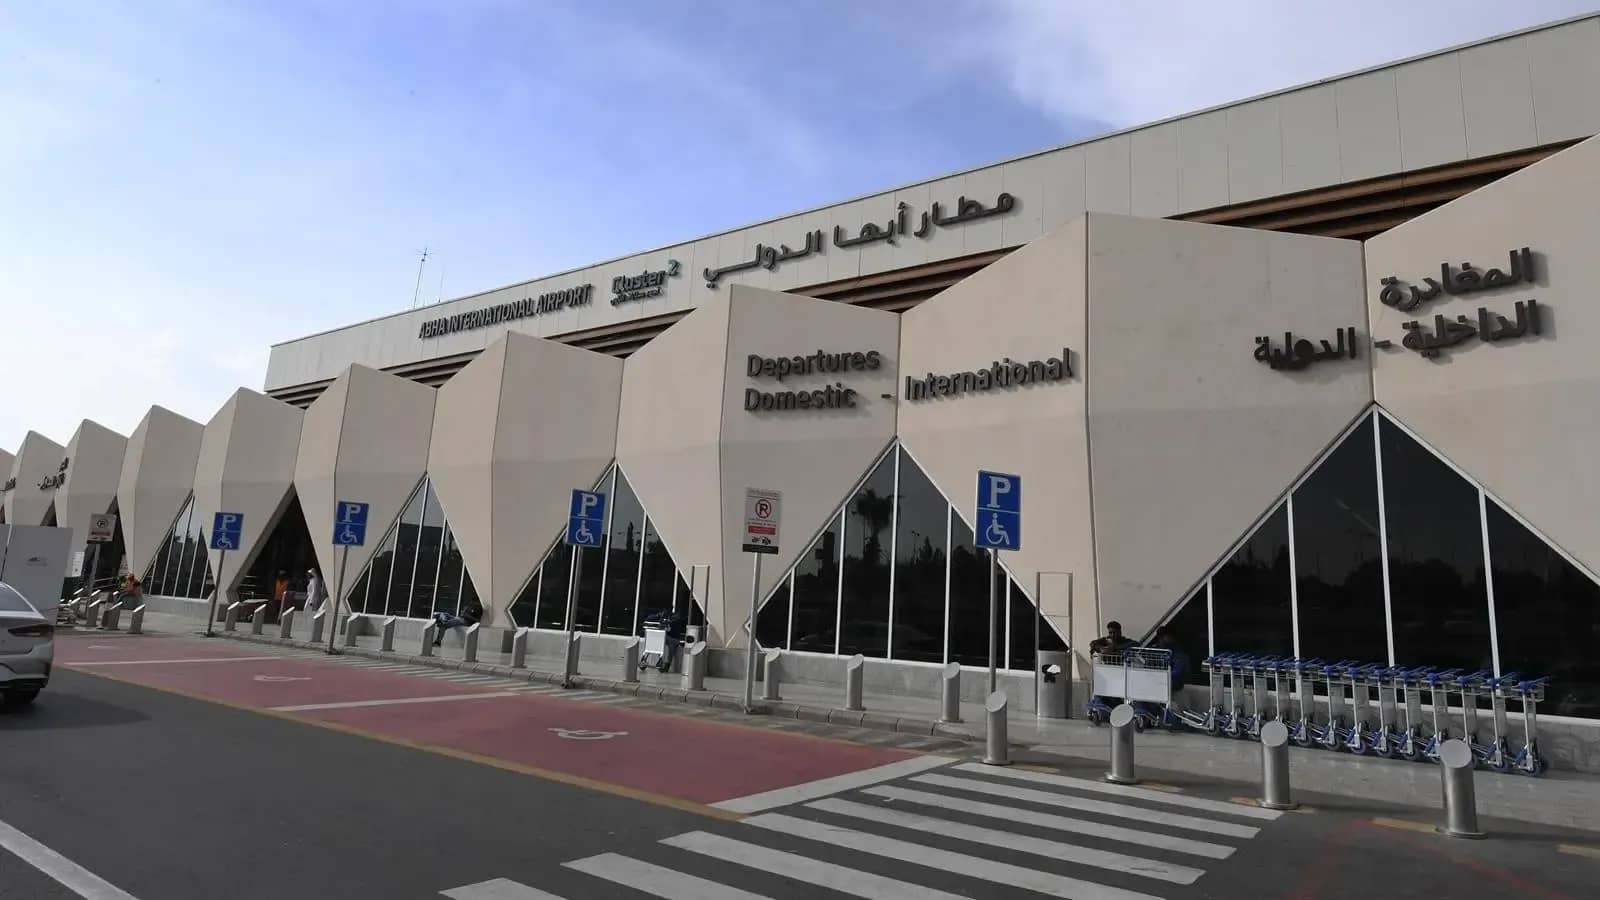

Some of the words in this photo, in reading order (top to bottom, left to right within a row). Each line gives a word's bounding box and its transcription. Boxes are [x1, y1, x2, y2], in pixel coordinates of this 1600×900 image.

[833, 202, 905, 248] أبها
[914, 192, 1015, 237] مطار
[703, 228, 821, 289] الدولي
[1380, 247, 1534, 312] المغادرة
[612, 269, 665, 294] Cluster
[418, 318, 448, 339] ABHA
[449, 297, 534, 333] INTERNATIONAL
[536, 283, 592, 314] AIRPORT
[1402, 299, 1541, 358] الداخلية
[747, 349, 881, 381] Departures
[1254, 327, 1356, 369] الدولية
[744, 382, 857, 411] Domestic
[905, 347, 1074, 401] International
[342, 503, 361, 522] P
[577, 493, 598, 517] P
[987, 476, 1011, 508] P
[219, 515, 237, 530] P
